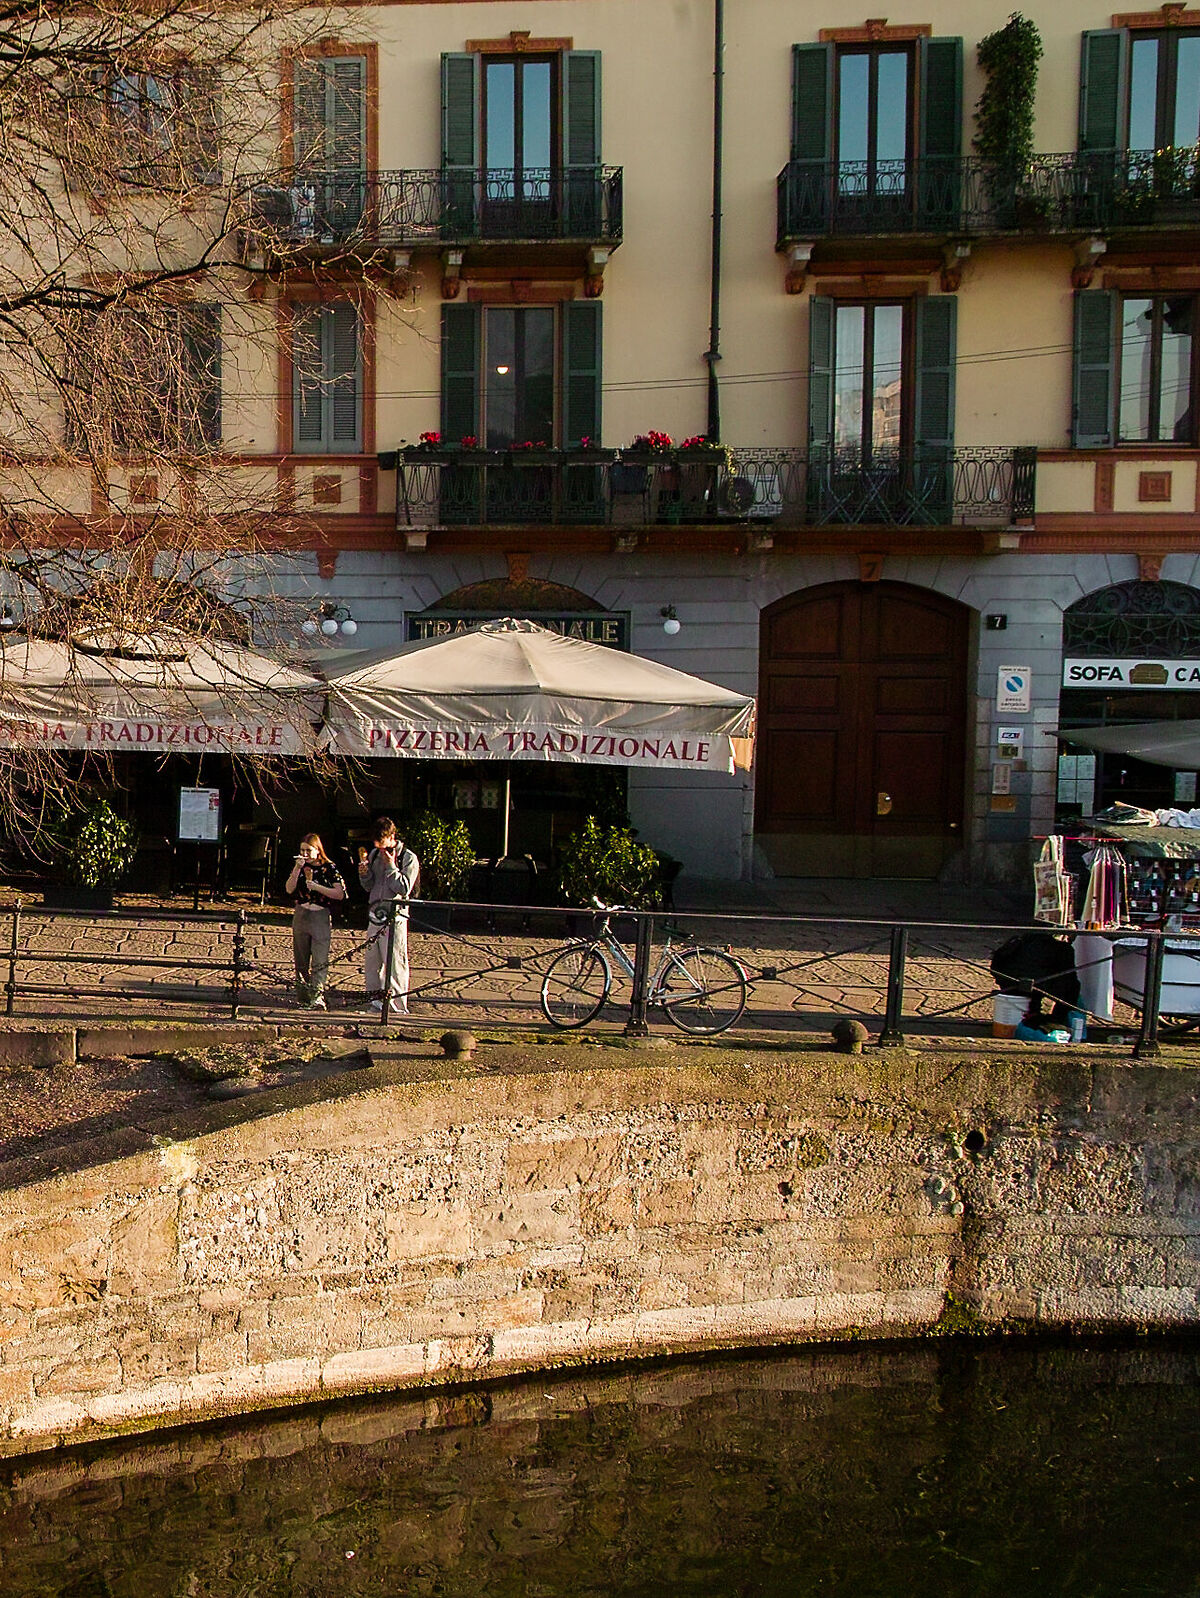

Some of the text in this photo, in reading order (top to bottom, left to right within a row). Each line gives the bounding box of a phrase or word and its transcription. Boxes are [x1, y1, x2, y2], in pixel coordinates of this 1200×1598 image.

[994, 616, 1002, 628] 7
[1069, 666, 1124, 681] SOFA
[369, 728, 711, 763] PIZZERIA TRADIZIONALE
